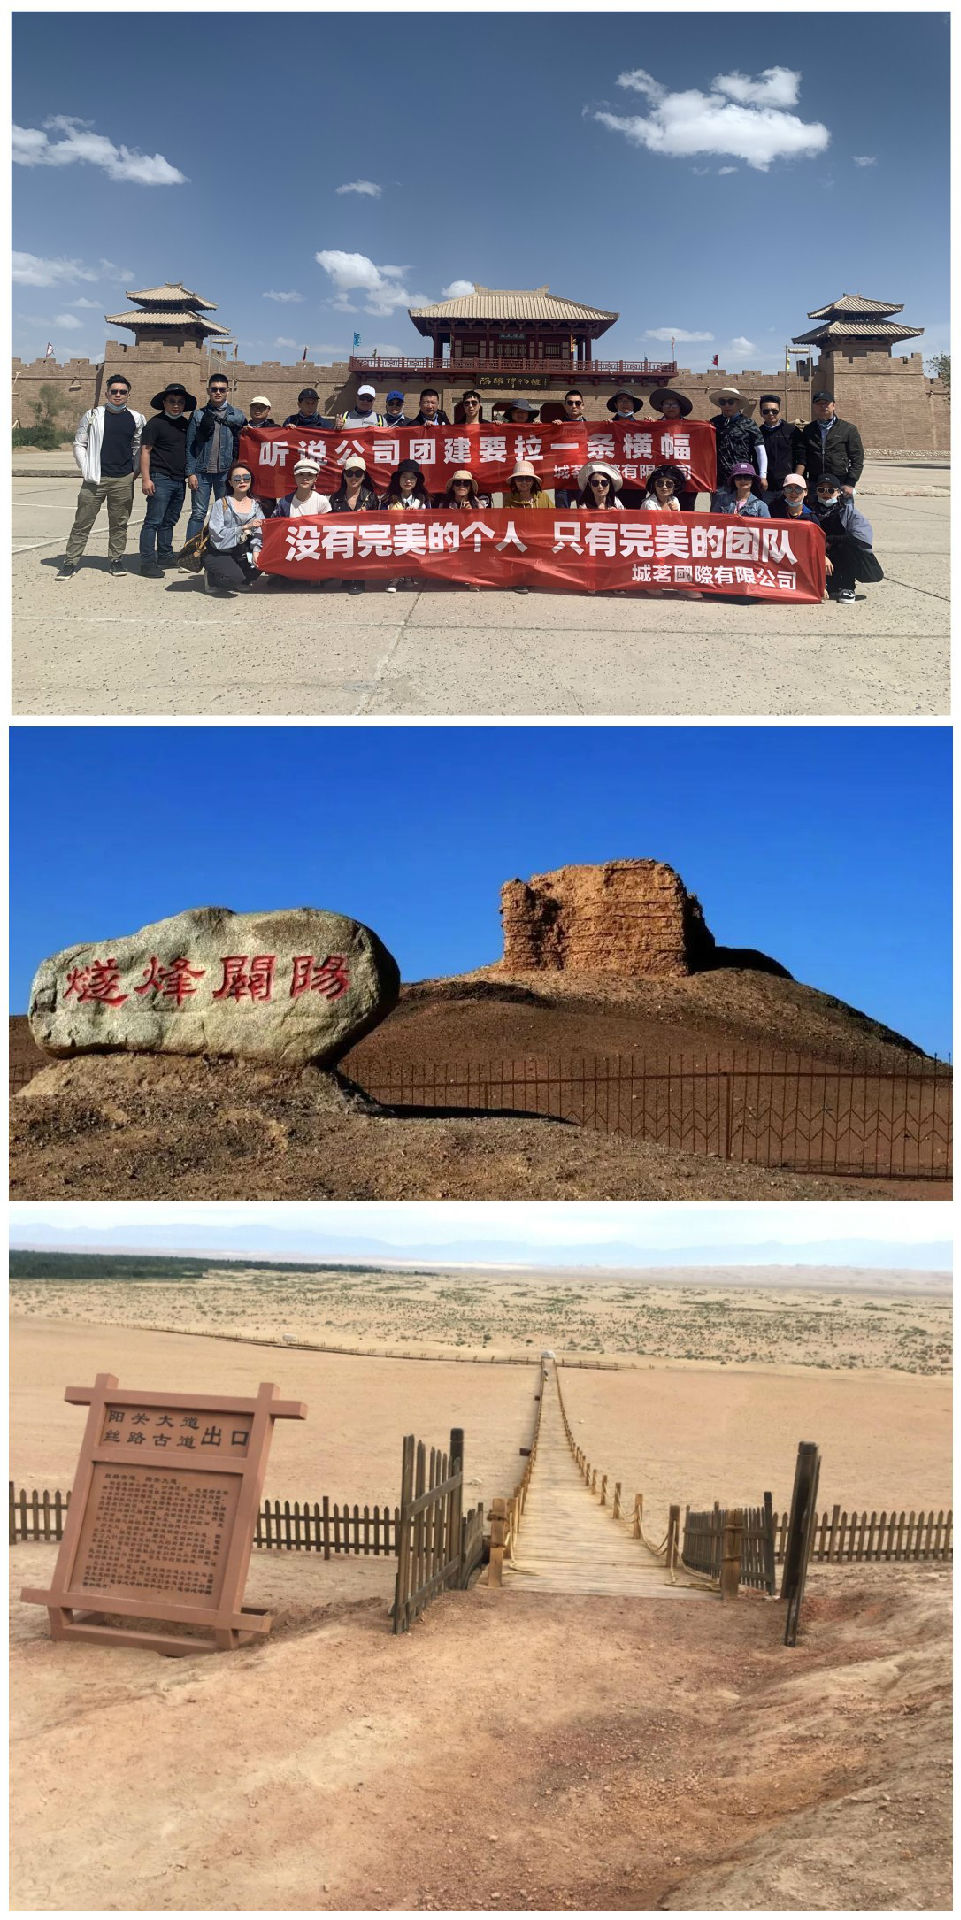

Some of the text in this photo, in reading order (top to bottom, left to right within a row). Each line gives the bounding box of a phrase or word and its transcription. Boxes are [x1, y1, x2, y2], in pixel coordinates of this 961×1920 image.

[259, 433, 691, 467] 听说公司团建要拉一条横幅
[285, 521, 798, 566] 没有完美的个人 只有完美的团队
[632, 564, 797, 590] 城茗國際有限公司
[108, 1409, 200, 1430] 阳关大道
[104, 1430, 197, 1449] 丝路古道
[201, 1425, 250, 1447] 出口
